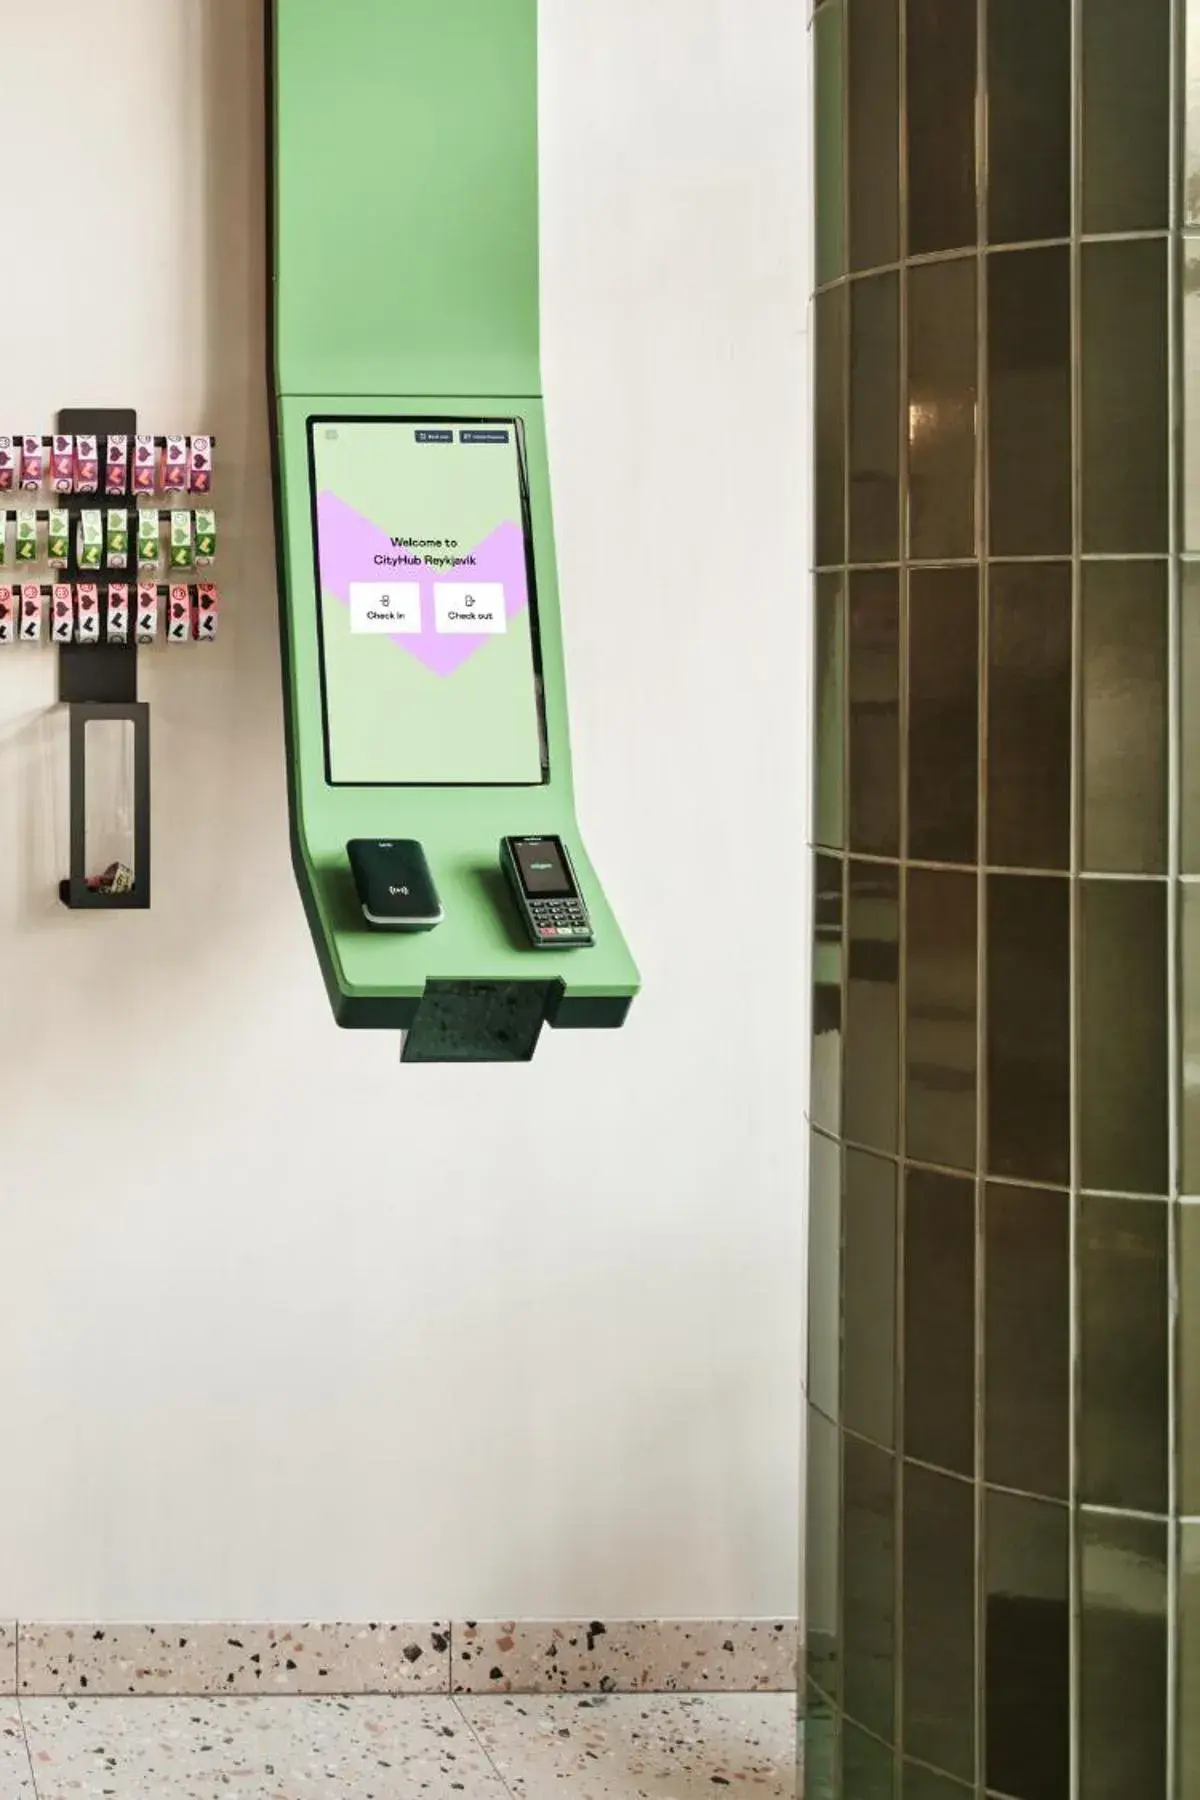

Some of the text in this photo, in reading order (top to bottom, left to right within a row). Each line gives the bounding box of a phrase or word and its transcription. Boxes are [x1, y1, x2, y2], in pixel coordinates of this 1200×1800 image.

[390, 537, 457, 548] Welcome to
[374, 555, 477, 567] CityHub Reykjavik
[367, 611, 406, 619] Check in
[448, 612, 476, 620] Check
